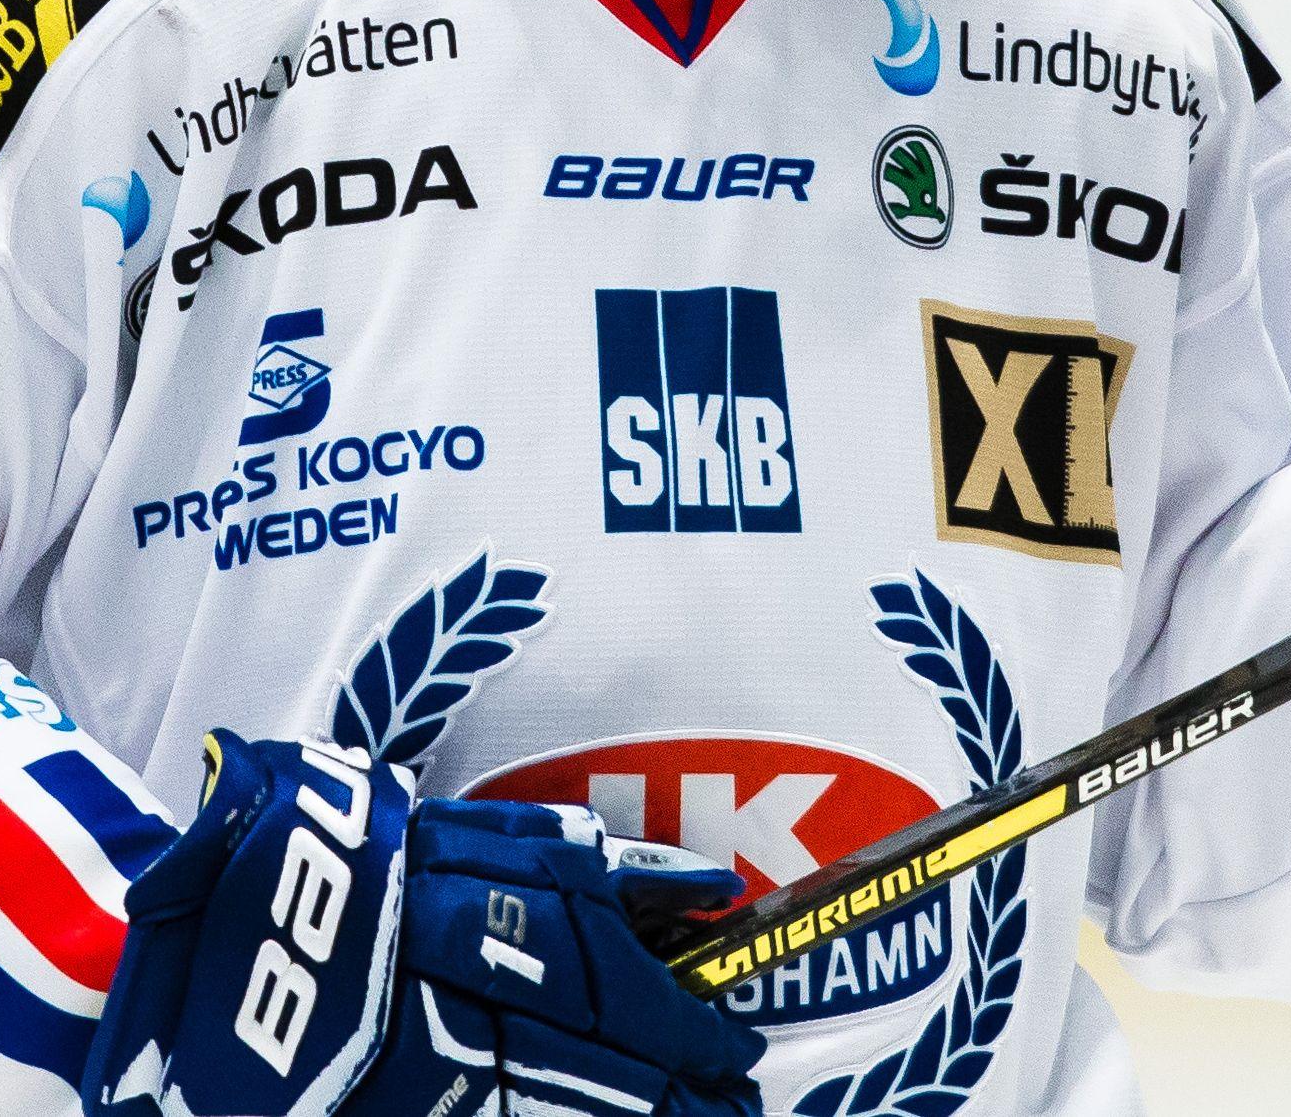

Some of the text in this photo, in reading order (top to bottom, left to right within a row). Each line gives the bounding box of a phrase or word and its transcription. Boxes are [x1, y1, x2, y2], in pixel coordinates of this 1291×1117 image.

[297, 425, 485, 491] KOGYO
[606, 392, 793, 508] SKB
[214, 493, 399, 571] WEDEN
[234, 733, 372, 1079] BAU
